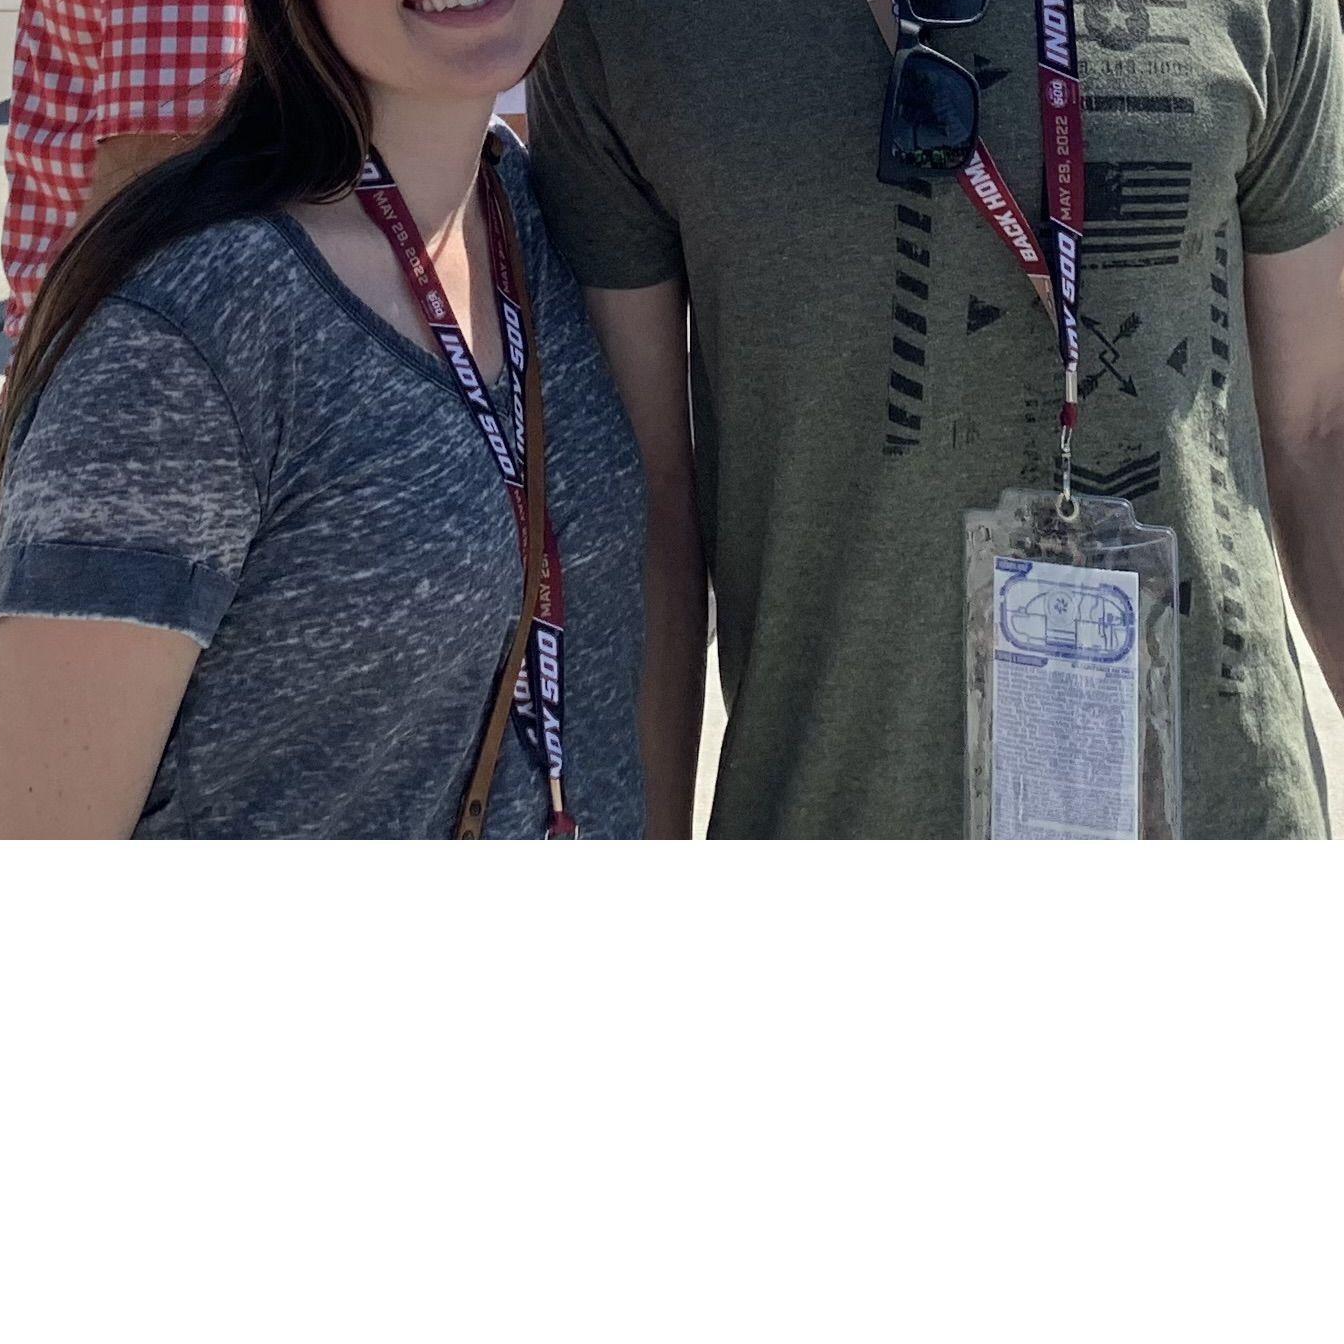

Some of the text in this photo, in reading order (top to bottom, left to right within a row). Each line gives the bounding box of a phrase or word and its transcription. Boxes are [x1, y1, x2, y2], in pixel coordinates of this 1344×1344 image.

[1055, 115, 1070, 157] 2022
[373, 190, 398, 221] MAY
[405, 247, 429, 286] 2022
[964, 150, 1039, 262] BACK HOM
[1059, 187, 1073, 221] MAY
[1058, 232, 1076, 303] 500
[503, 302, 525, 372] 500
[439, 332, 517, 479] INDY 500
[538, 584, 553, 617] MAY
[537, 629, 563, 778] NDY 500
